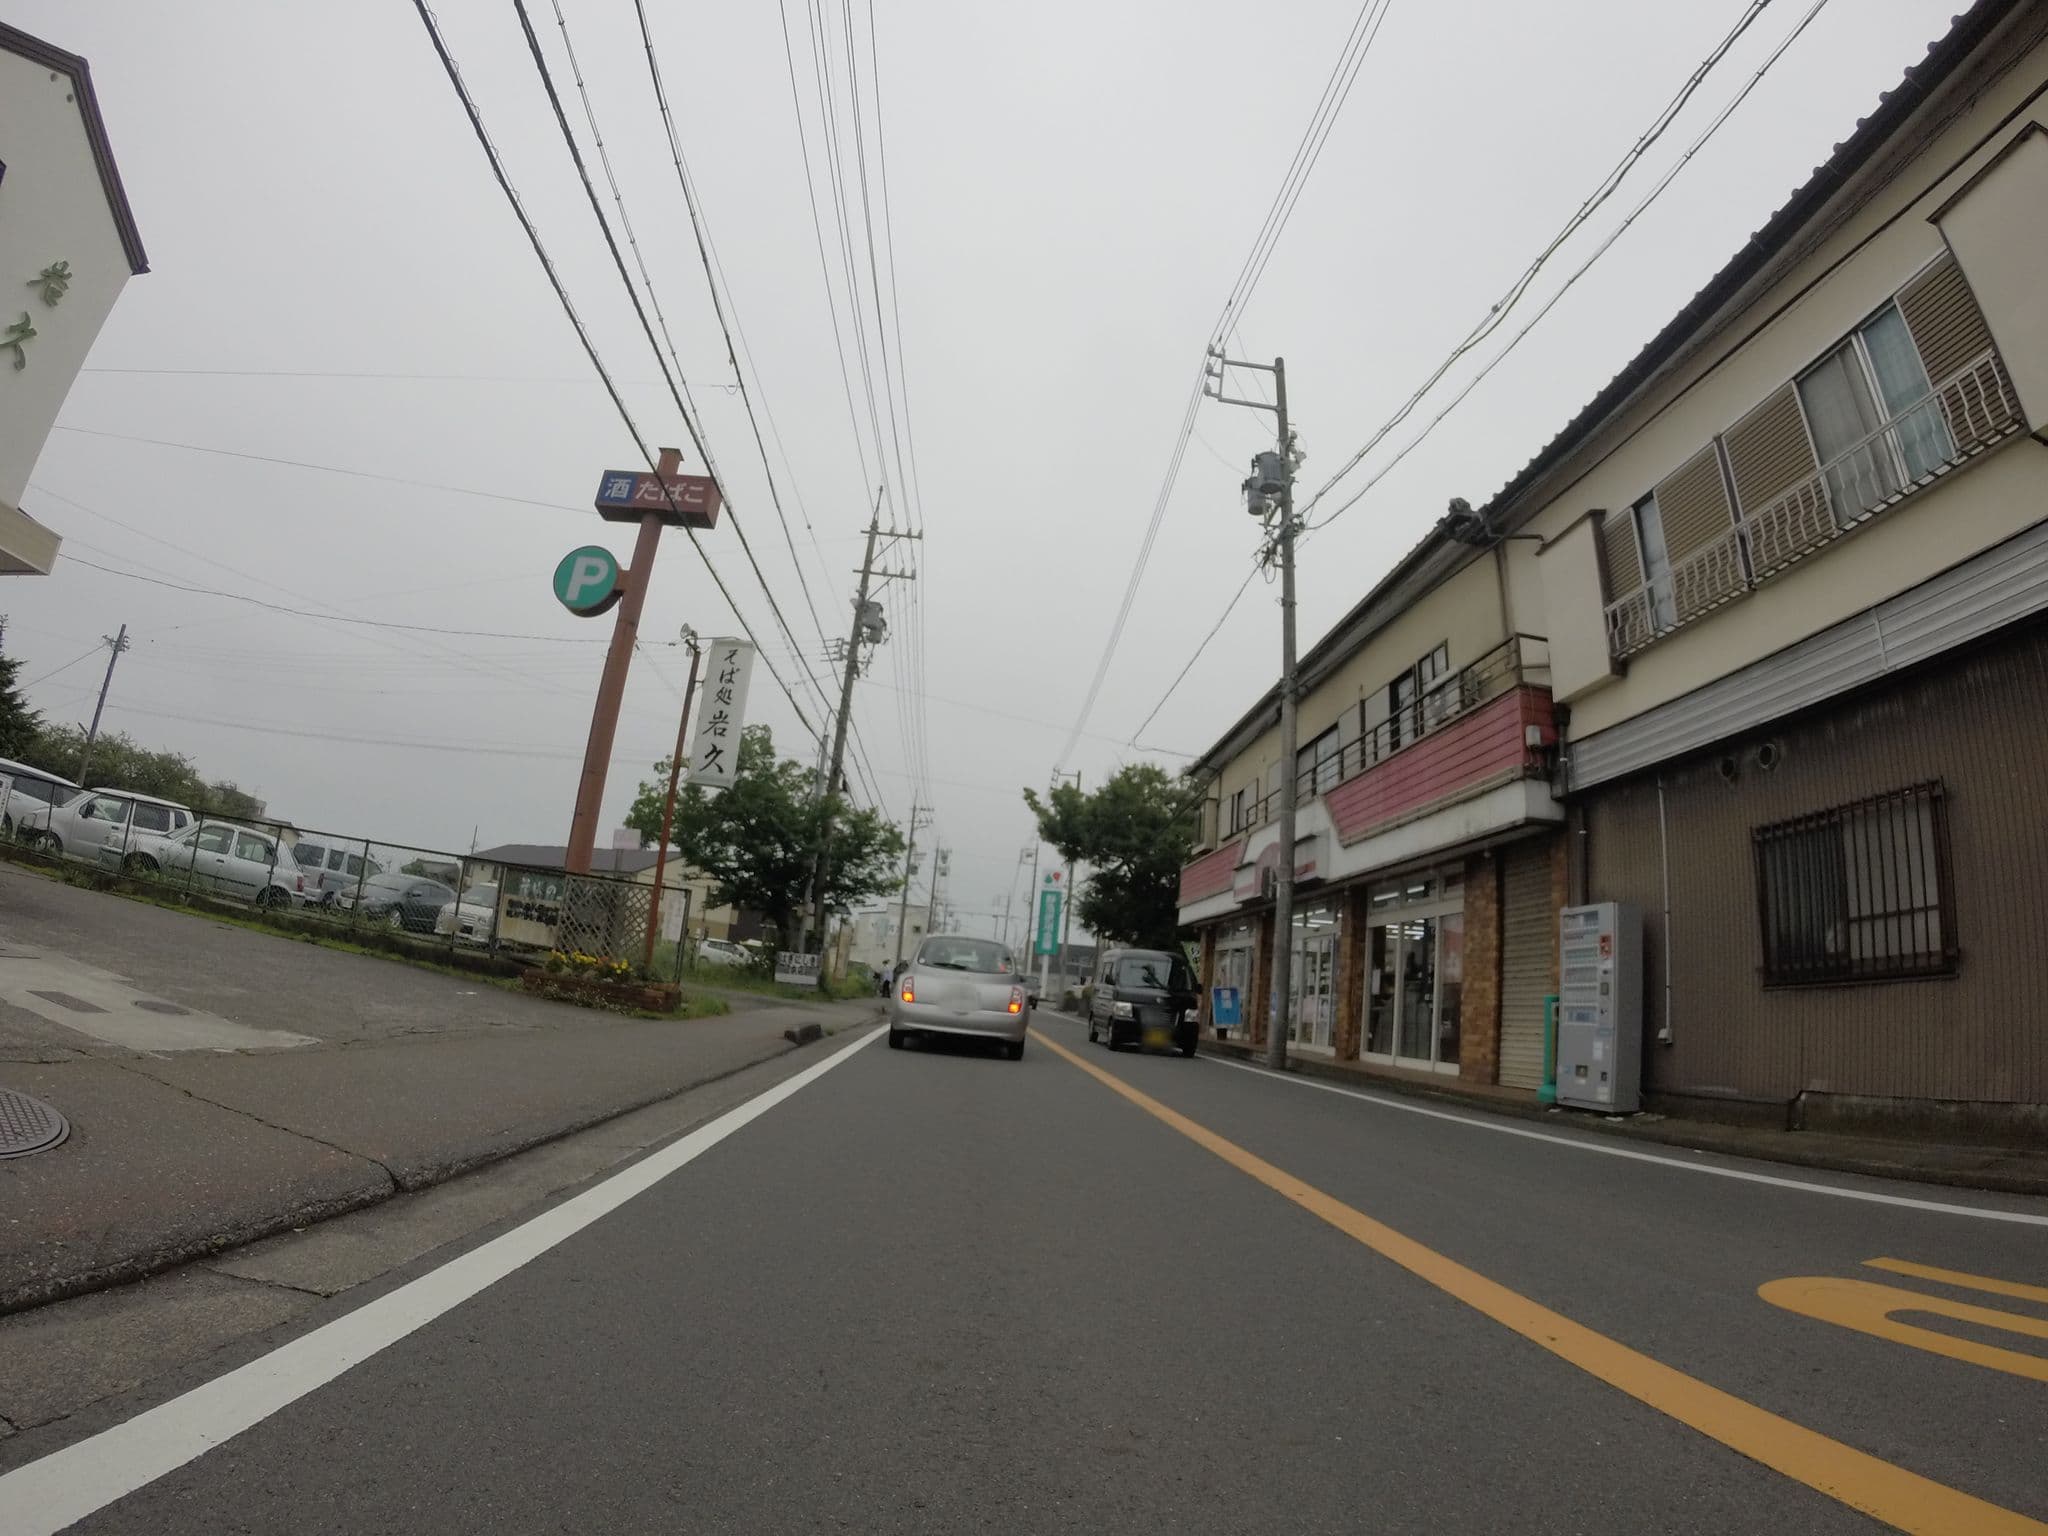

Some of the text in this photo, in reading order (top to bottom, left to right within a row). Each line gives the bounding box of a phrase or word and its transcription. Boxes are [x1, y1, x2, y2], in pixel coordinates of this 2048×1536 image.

[604, 478, 705, 504] 酒 たばこ
[566, 556, 609, 602] P
[699, 649, 740, 773] そば処岩久
